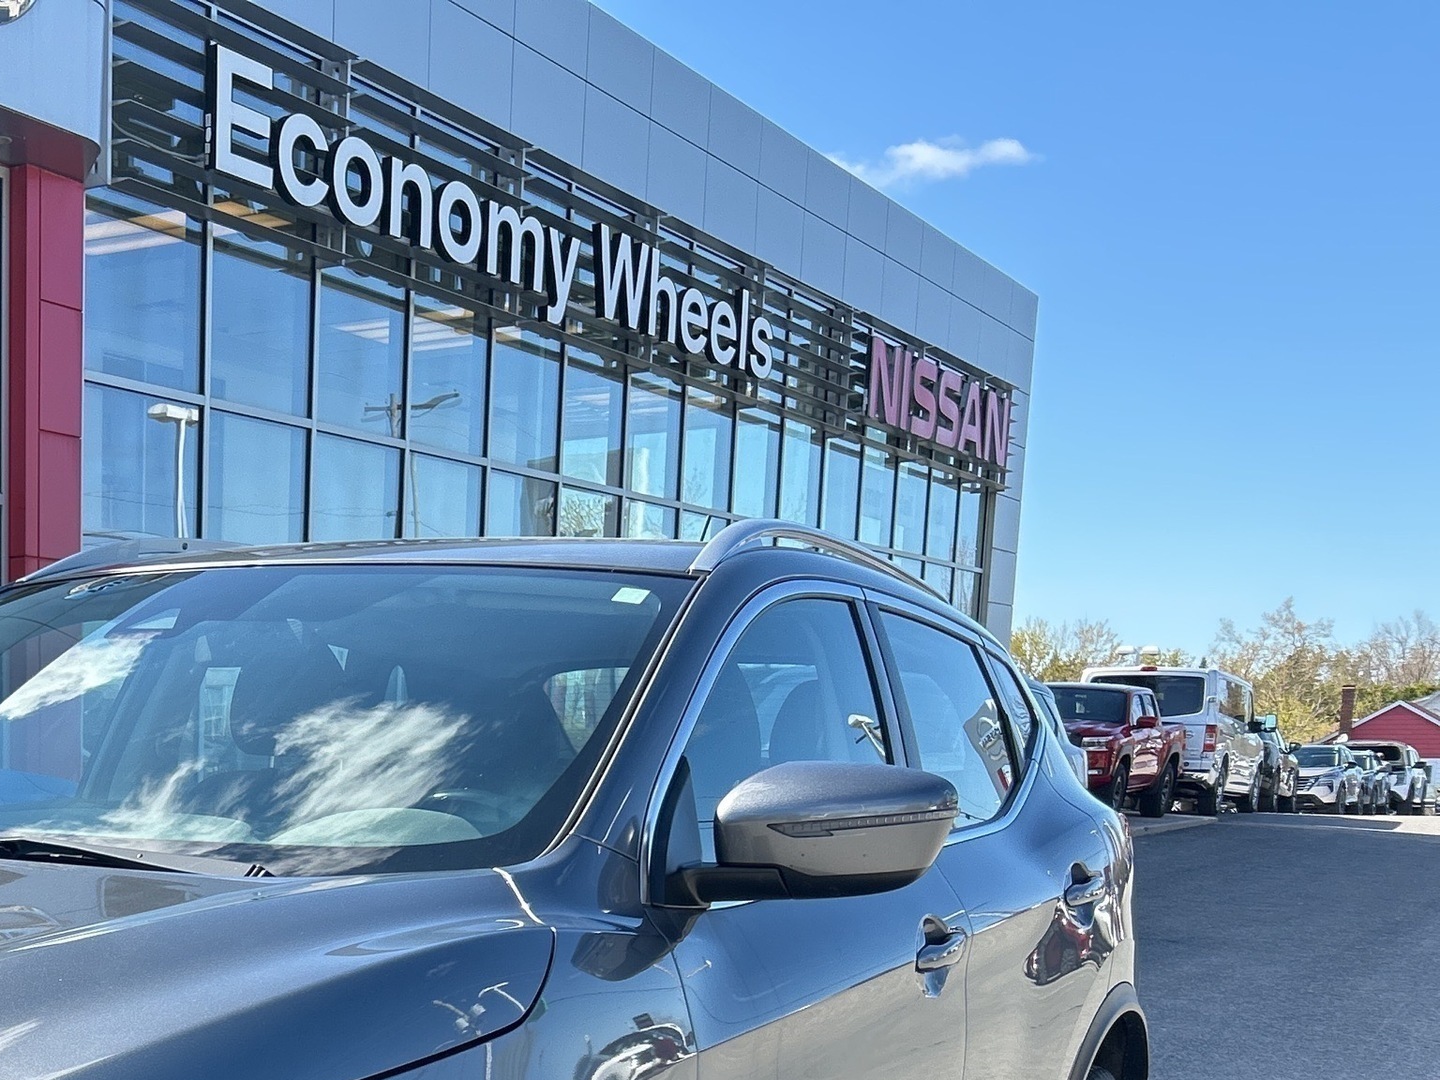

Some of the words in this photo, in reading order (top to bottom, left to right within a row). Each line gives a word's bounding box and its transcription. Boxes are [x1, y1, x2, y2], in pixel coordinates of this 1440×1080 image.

[212, 43, 579, 325] Economy
[597, 224, 773, 380] Wheels
[869, 336, 1010, 467] NISSAN
